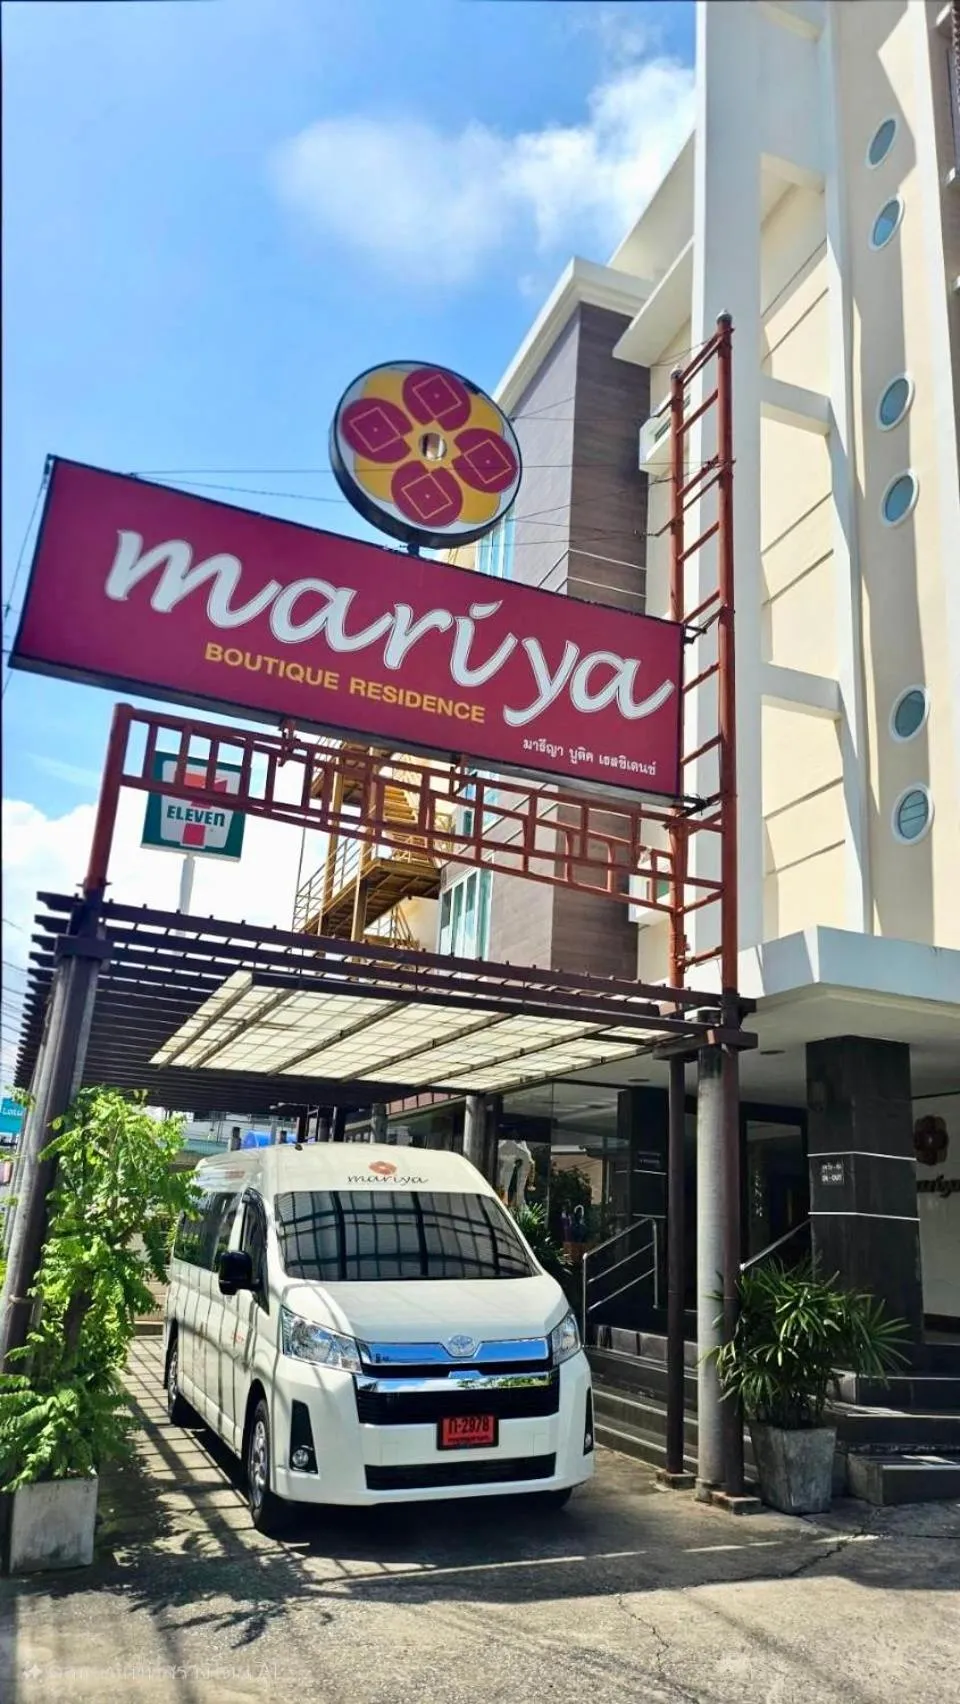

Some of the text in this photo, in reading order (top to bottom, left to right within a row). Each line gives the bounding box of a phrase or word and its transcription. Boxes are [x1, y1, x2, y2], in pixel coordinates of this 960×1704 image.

[105, 529, 674, 727] mariya
[205, 642, 486, 723] BOUTIQUE RESIDENCE
[347, 1175, 429, 1187] mariya
